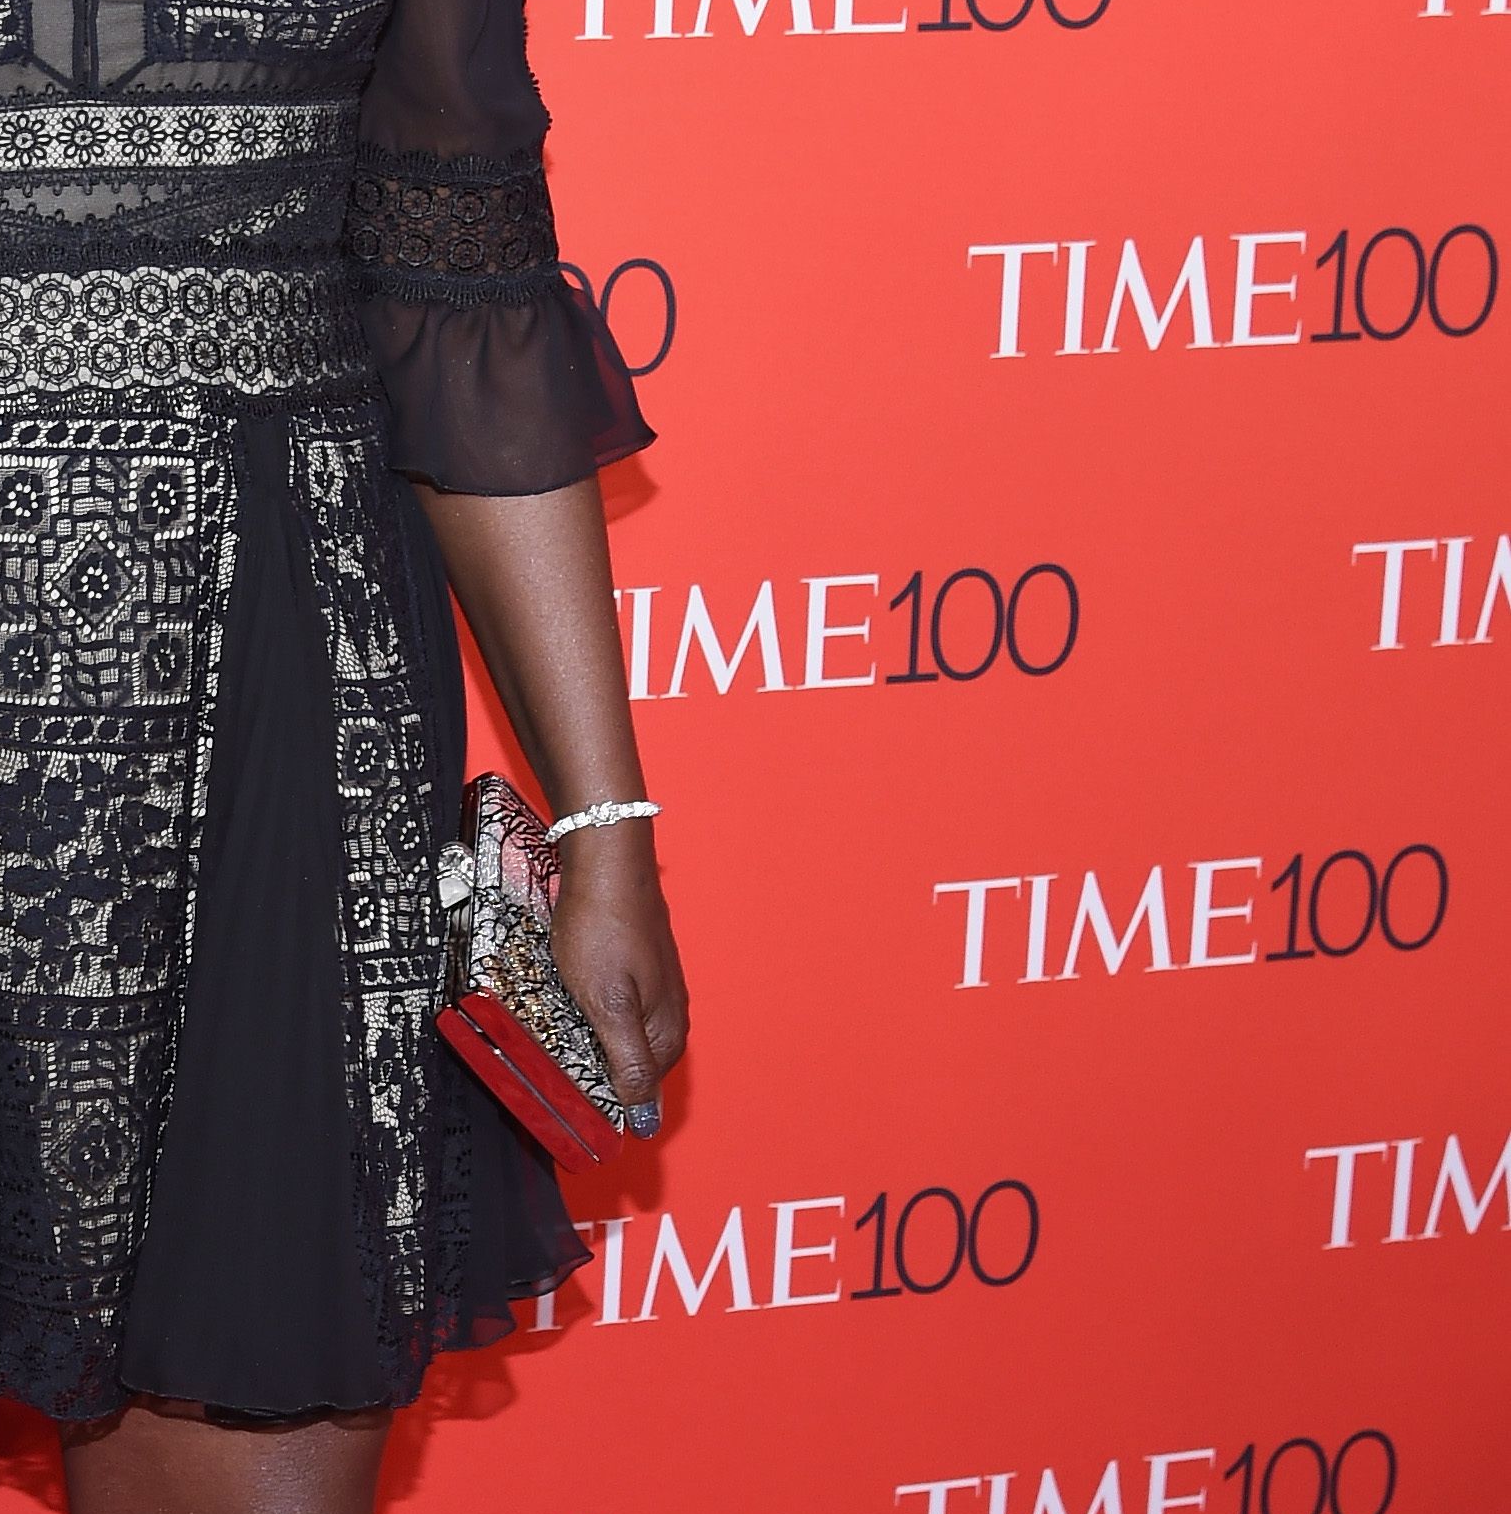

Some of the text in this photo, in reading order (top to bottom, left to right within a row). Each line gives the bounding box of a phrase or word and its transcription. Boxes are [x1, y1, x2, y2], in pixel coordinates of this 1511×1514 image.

[967, 224, 1498, 359] TIME100
[612, 562, 1079, 701] IME100
[932, 844, 1449, 989] TIME100
